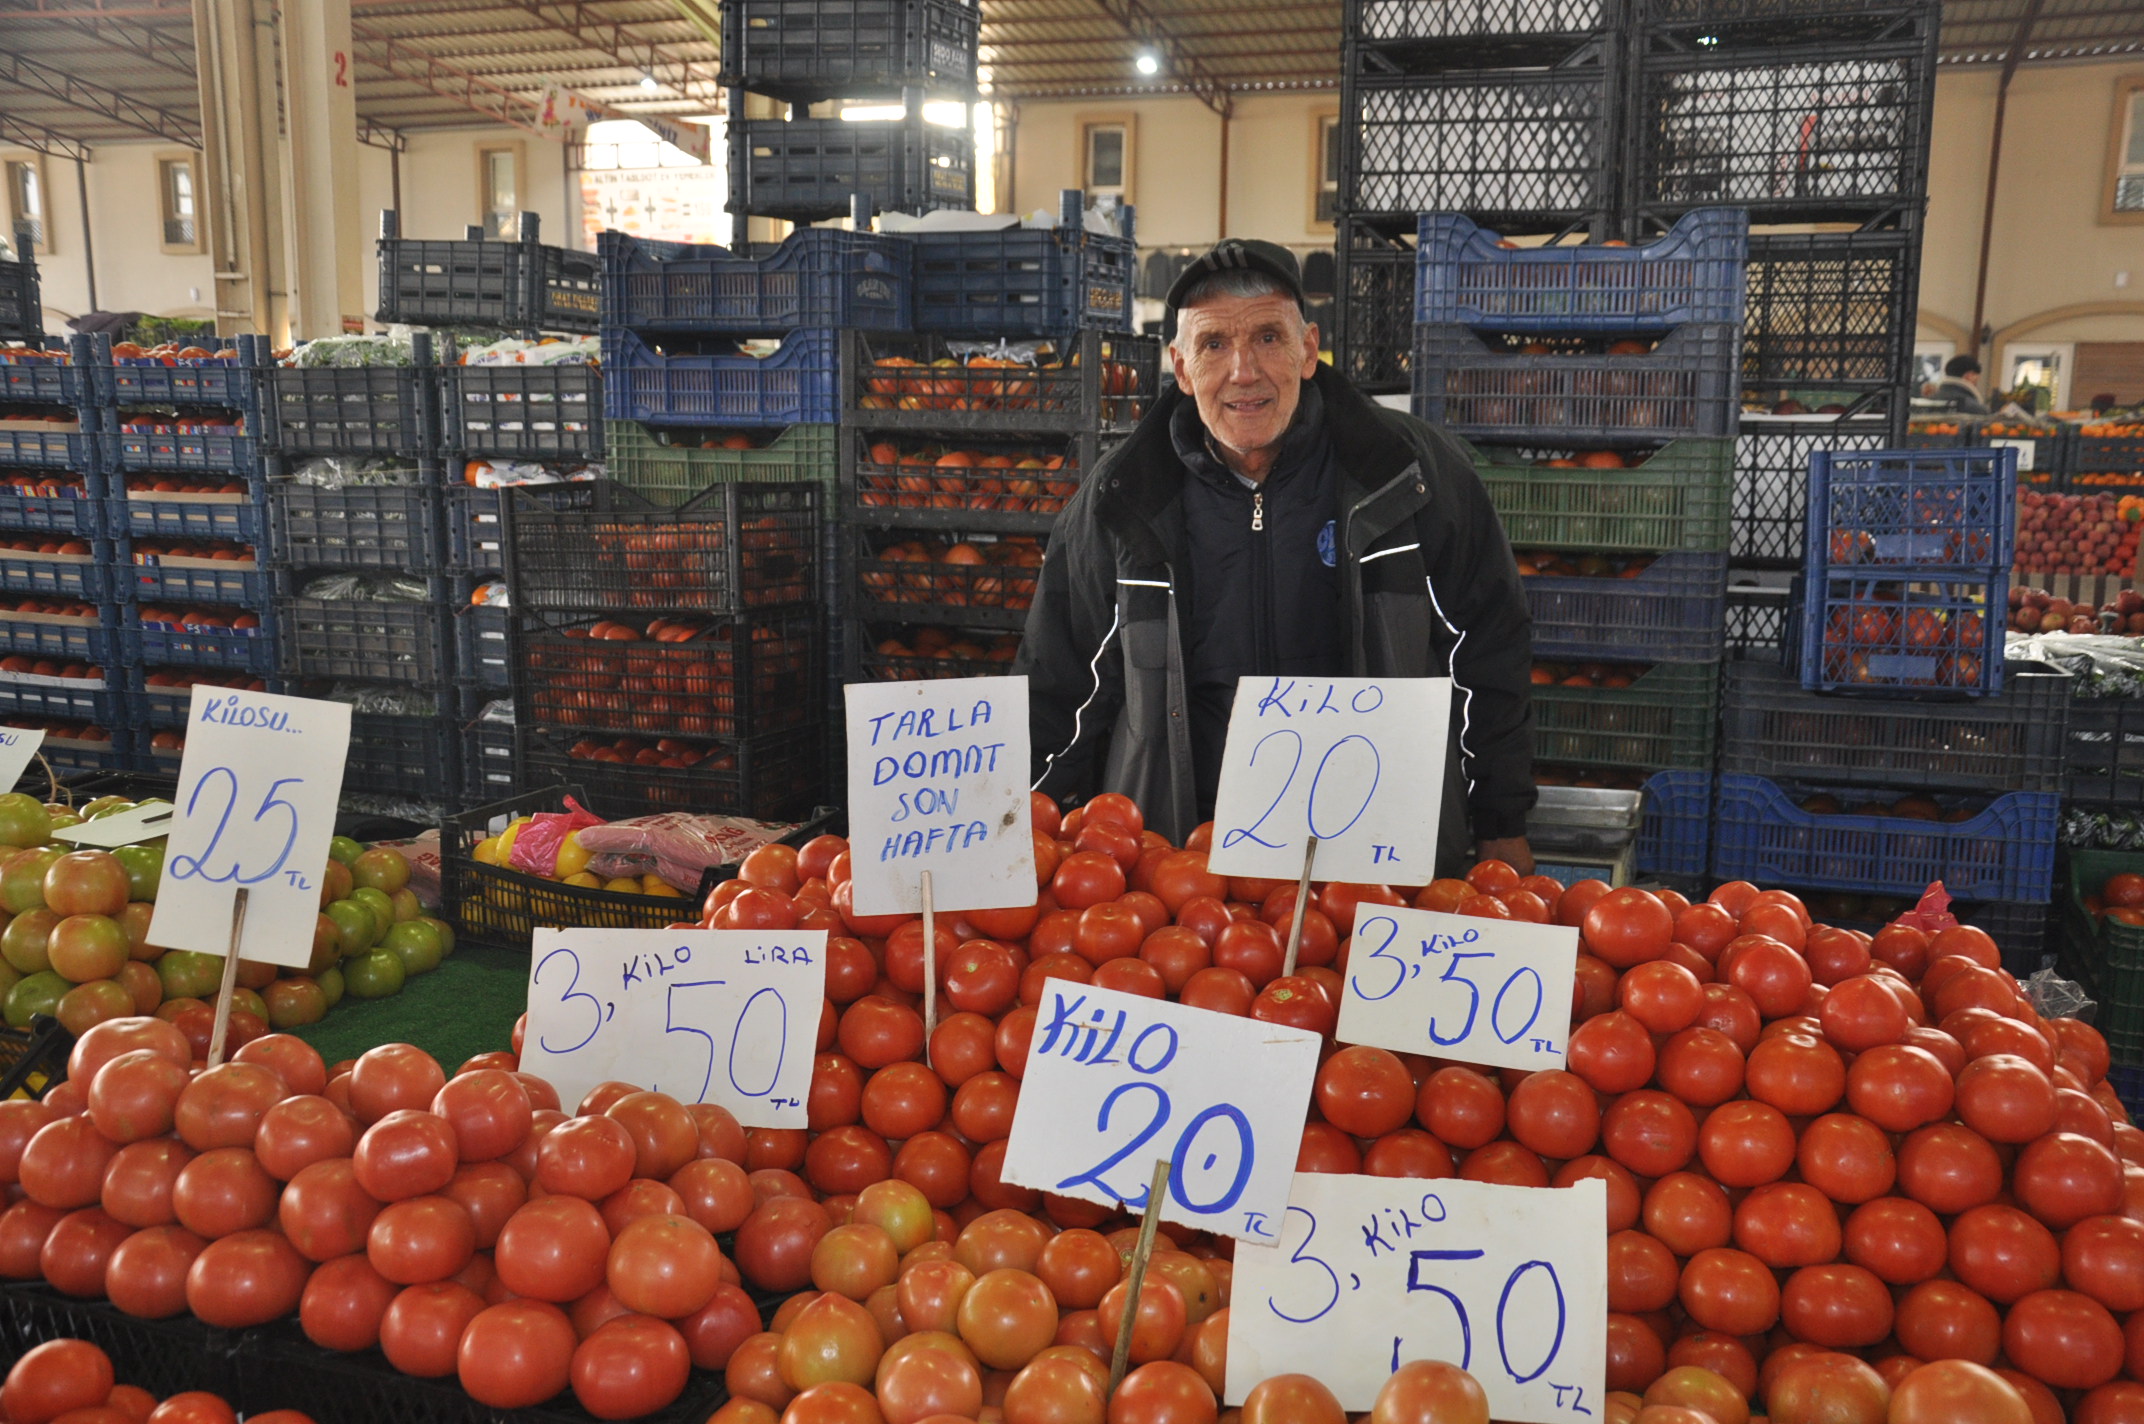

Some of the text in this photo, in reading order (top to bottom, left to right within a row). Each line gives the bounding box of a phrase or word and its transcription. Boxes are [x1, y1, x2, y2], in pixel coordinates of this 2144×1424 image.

[334, 51, 347, 87] 2
[868, 699, 992, 747] TARLA
[891, 787, 959, 822] SON
[1222, 729, 1401, 864] 20 TL
[169, 766, 312, 890] 25 TL
[880, 820, 988, 862] HAFTA
[1351, 916, 1562, 1055] 3,50 TL
[1055, 1081, 1255, 1215] 20
[1547, 1380, 1593, 1416] TL
